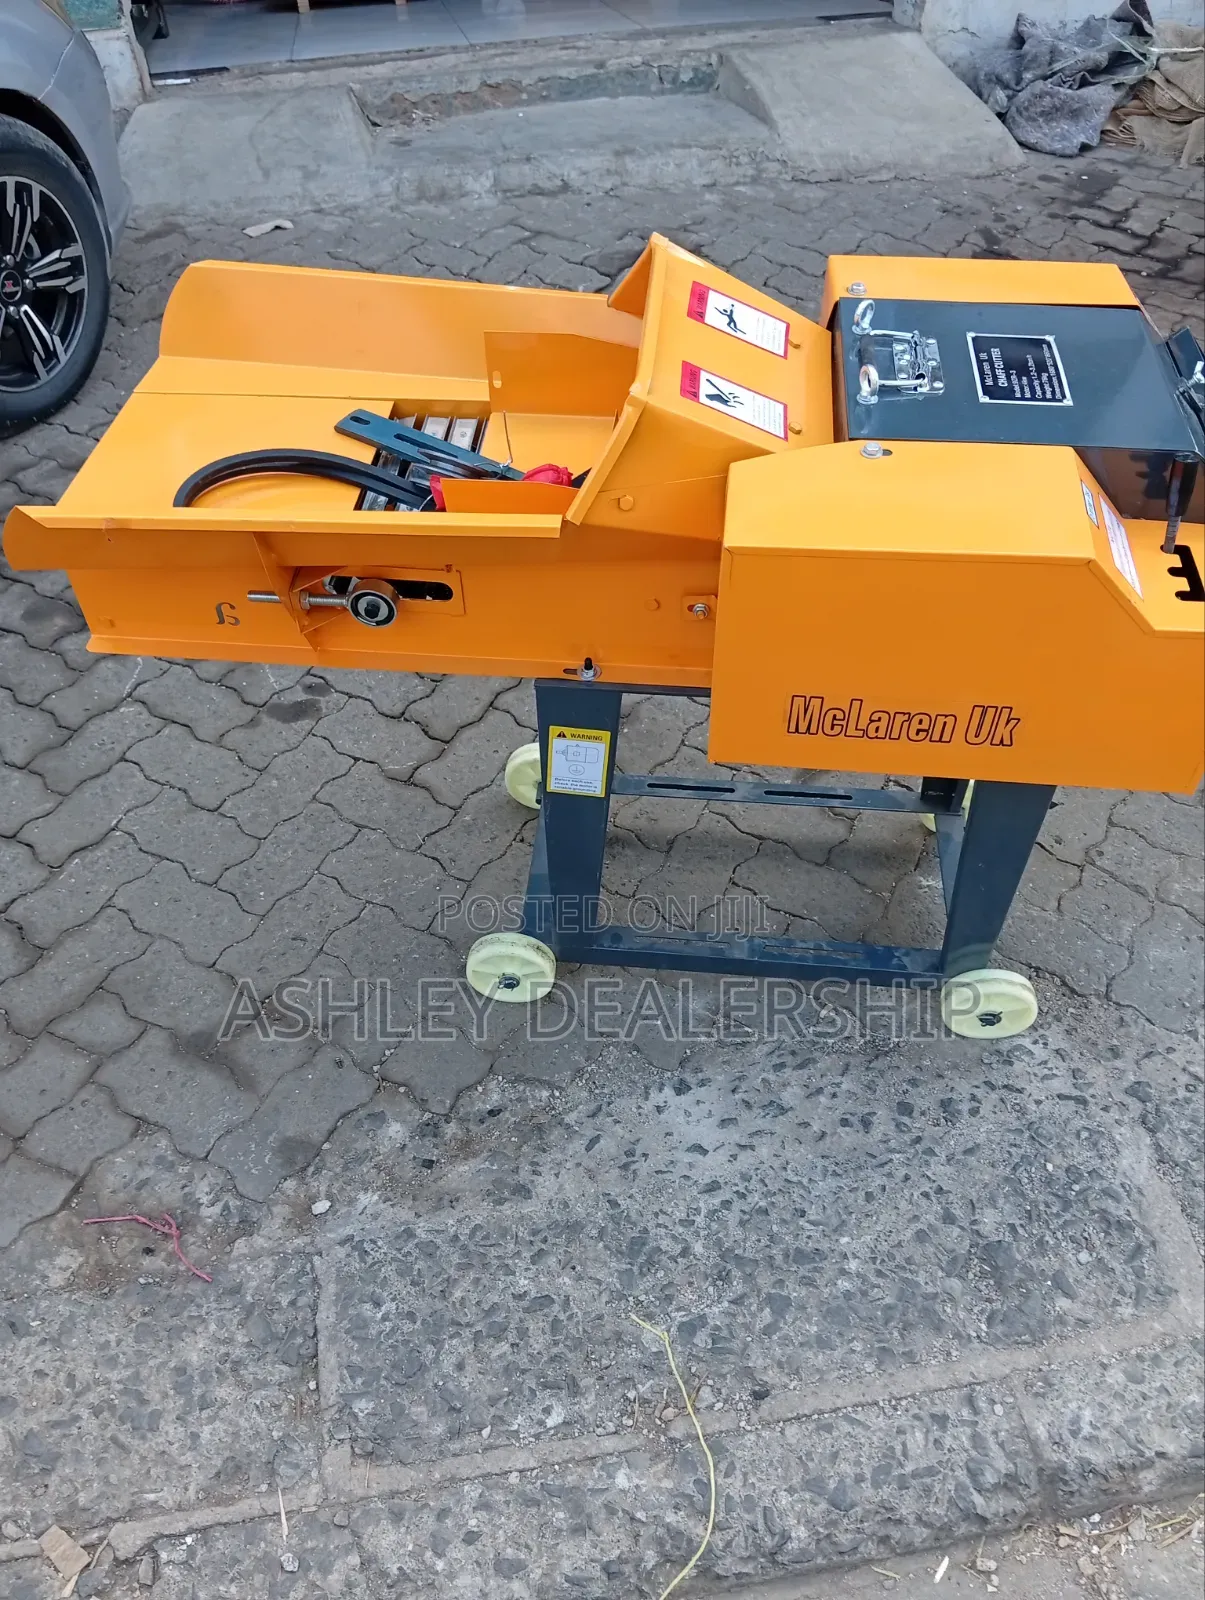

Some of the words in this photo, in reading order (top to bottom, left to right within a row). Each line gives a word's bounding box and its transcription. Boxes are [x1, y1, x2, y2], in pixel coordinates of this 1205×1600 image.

[990, 347, 1004, 368] CUTTER
[981, 361, 993, 385] McLaren
[995, 368, 1008, 386] CHAFF
[787, 695, 957, 743] McLaren
[964, 704, 1021, 747] Uk
[570, 732, 603, 741] WARNING
